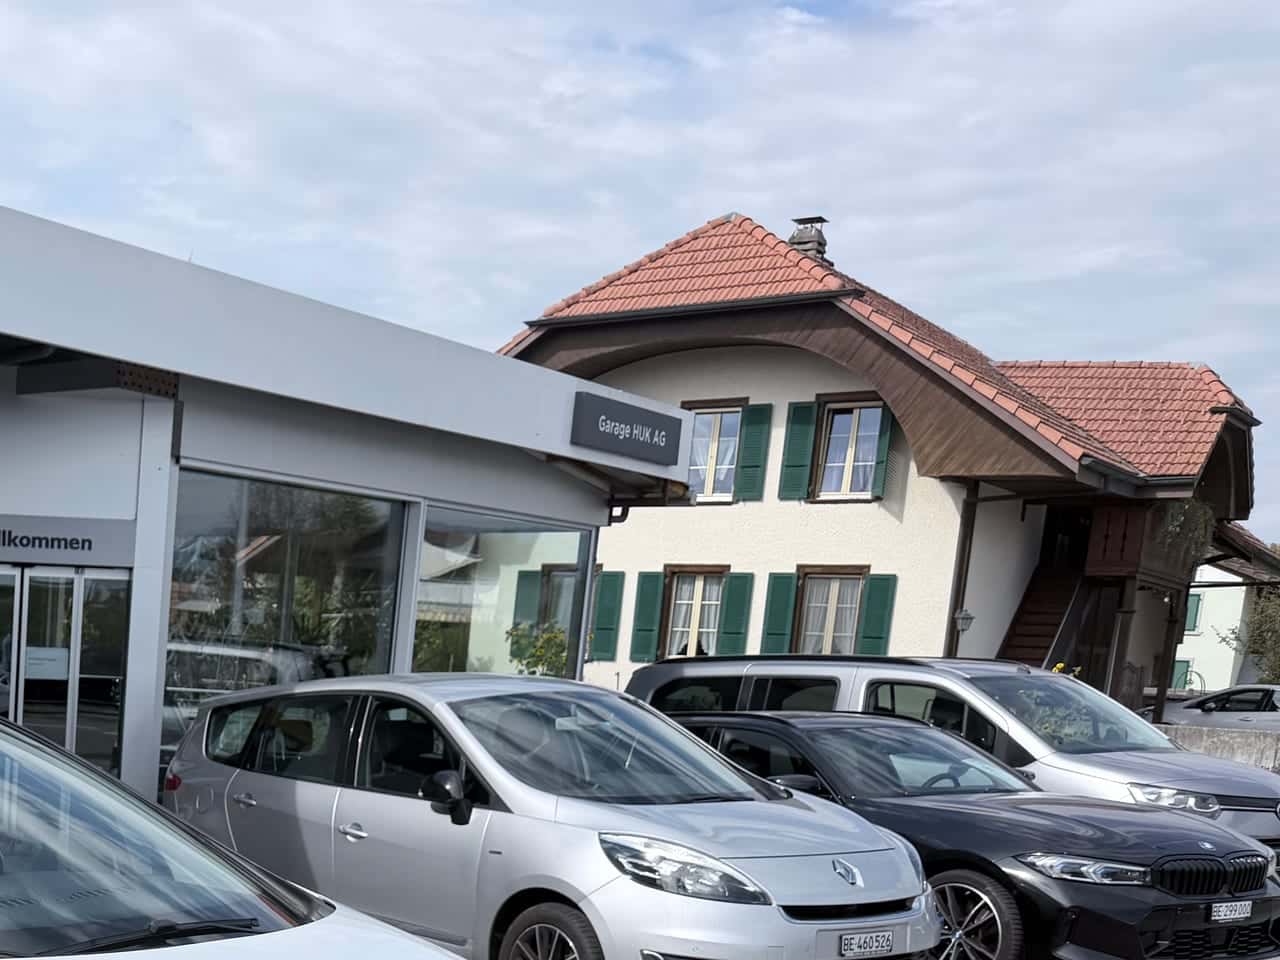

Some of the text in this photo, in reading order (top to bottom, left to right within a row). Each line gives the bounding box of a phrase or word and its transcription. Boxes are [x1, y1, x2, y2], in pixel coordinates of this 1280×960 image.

[598, 415, 667, 447] Garage HUK AG
